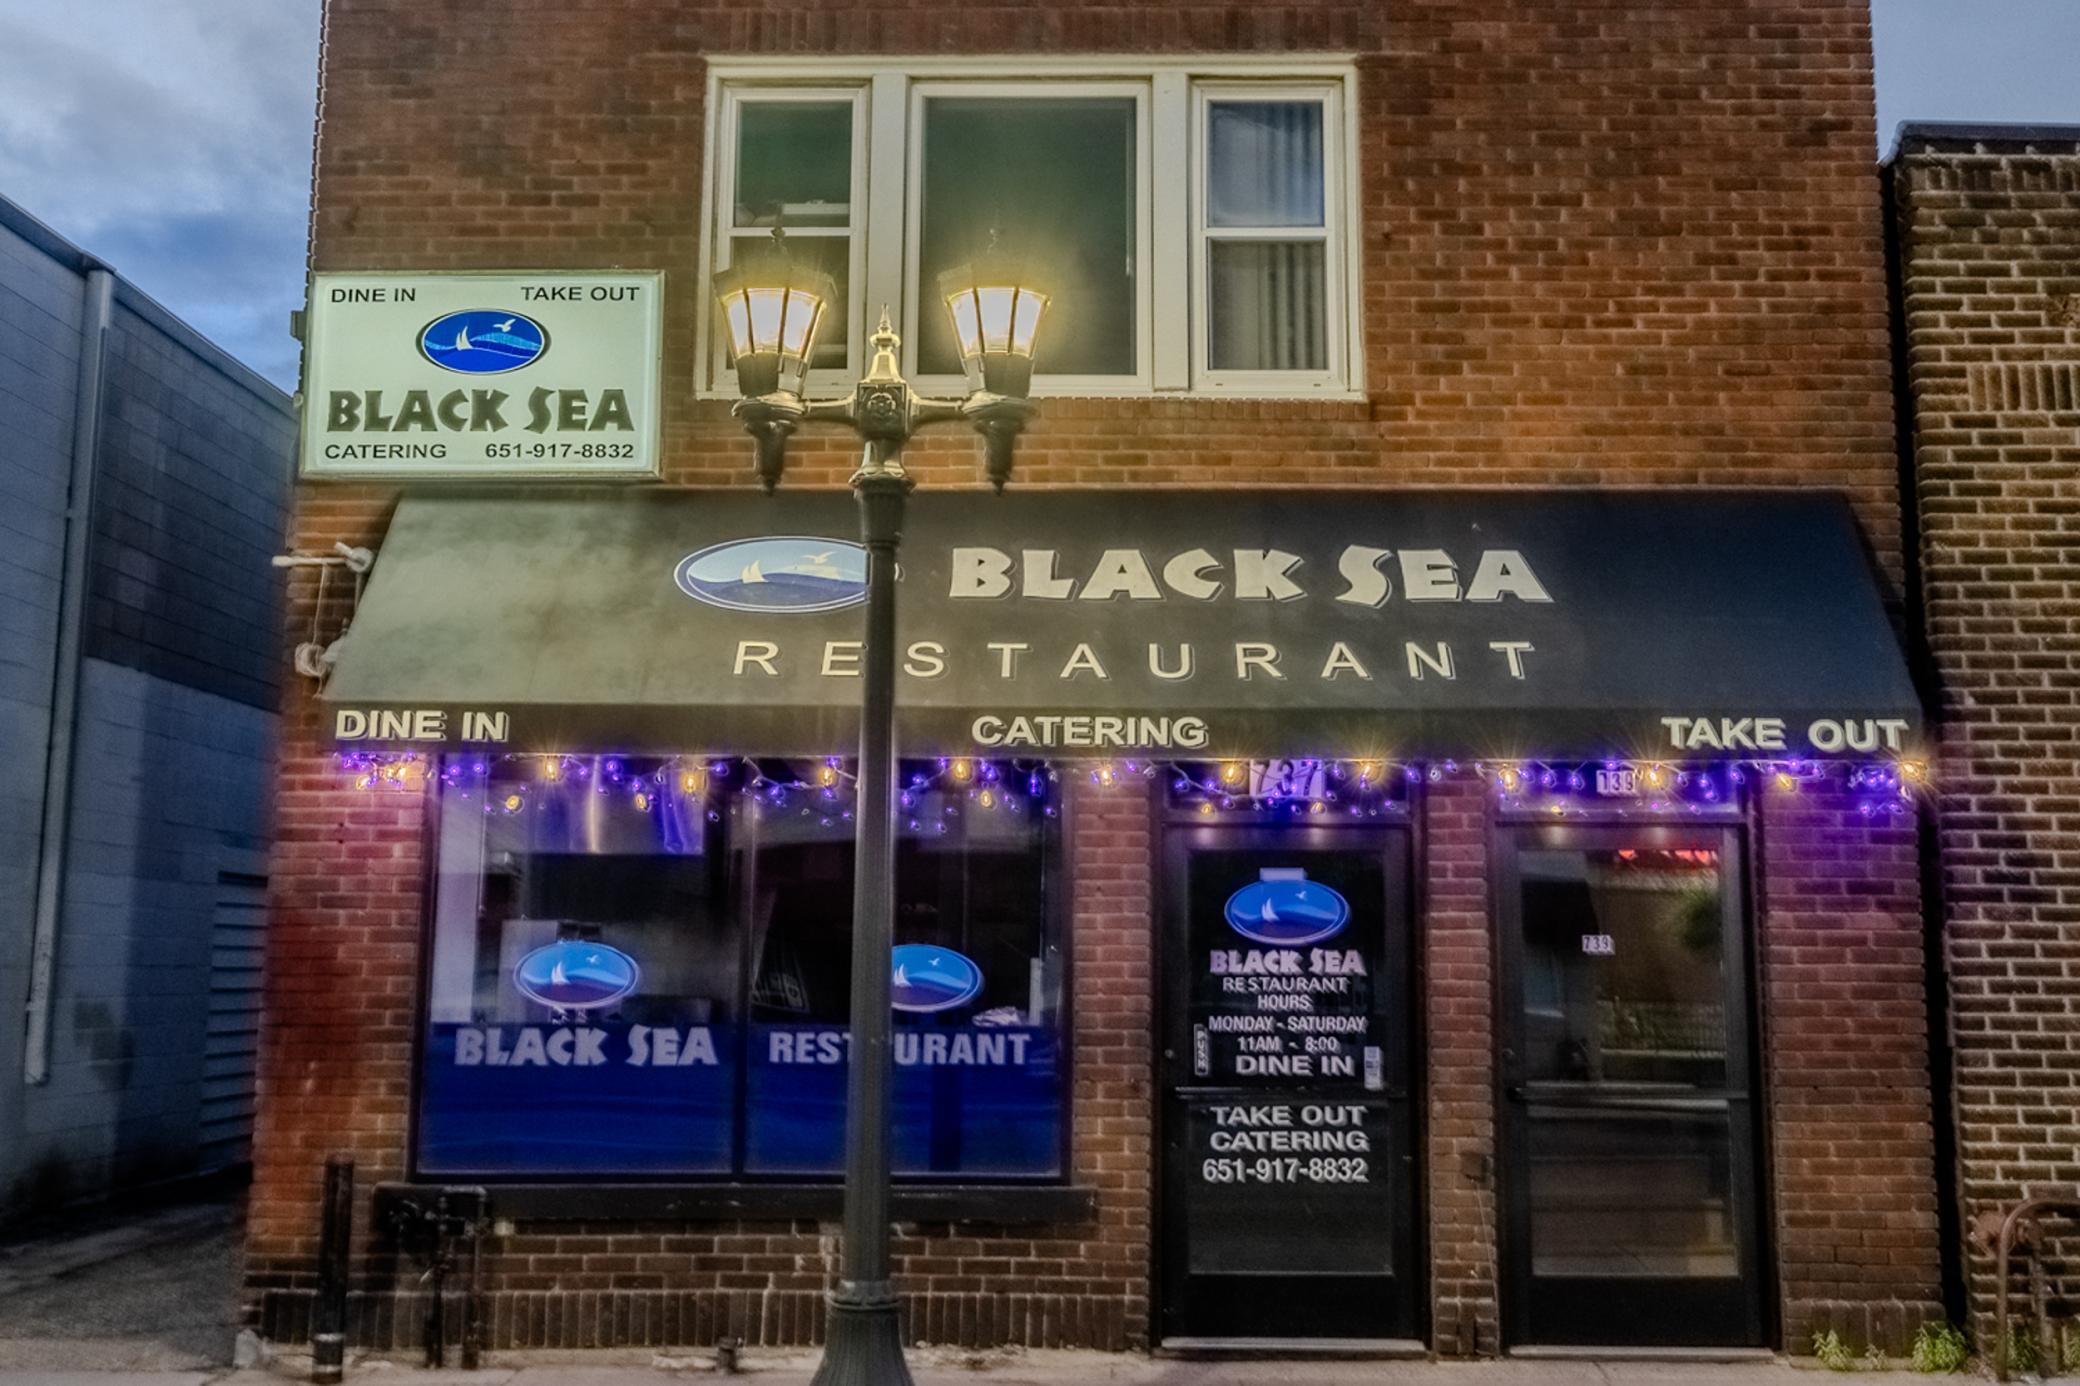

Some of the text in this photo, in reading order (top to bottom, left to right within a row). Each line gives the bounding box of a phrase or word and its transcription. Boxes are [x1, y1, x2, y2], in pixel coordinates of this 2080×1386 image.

[331, 287, 416, 303] DINE IN
[521, 286, 641, 302] TAKE OUT
[327, 386, 635, 434] BLACK SEA
[325, 443, 447, 459] CATERING
[485, 443, 634, 459] 651-917-8832
[949, 544, 1554, 608] BLACK SEA
[733, 640, 1534, 681] RESTAURANT
[335, 709, 510, 743] DINE IN
[971, 715, 1209, 748] CATERING
[1661, 716, 1909, 752] TAKE OUT
[1253, 759, 1319, 797] 737
[1583, 935, 1610, 950] 739
[1209, 947, 1368, 976] BLACK SEA
[1222, 977, 1350, 994] RESTAURANT
[1257, 994, 1314, 1011] HOURS
[1208, 1015, 1276, 1033] MONDAY
[1287, 1015, 1369, 1033] SATURDAY
[454, 1023, 719, 1067] BLACK SEA
[768, 1031, 1032, 1066] RESURANT
[1237, 1035, 1284, 1053] 11AM
[1304, 1035, 1341, 1053] 8:00
[1235, 1055, 1313, 1077] DINE
[1321, 1055, 1355, 1077] IN
[1210, 1105, 1368, 1127] TAKE OUT
[1209, 1130, 1371, 1152] CATERING
[1202, 1157, 1370, 1183] 651-917-8832
